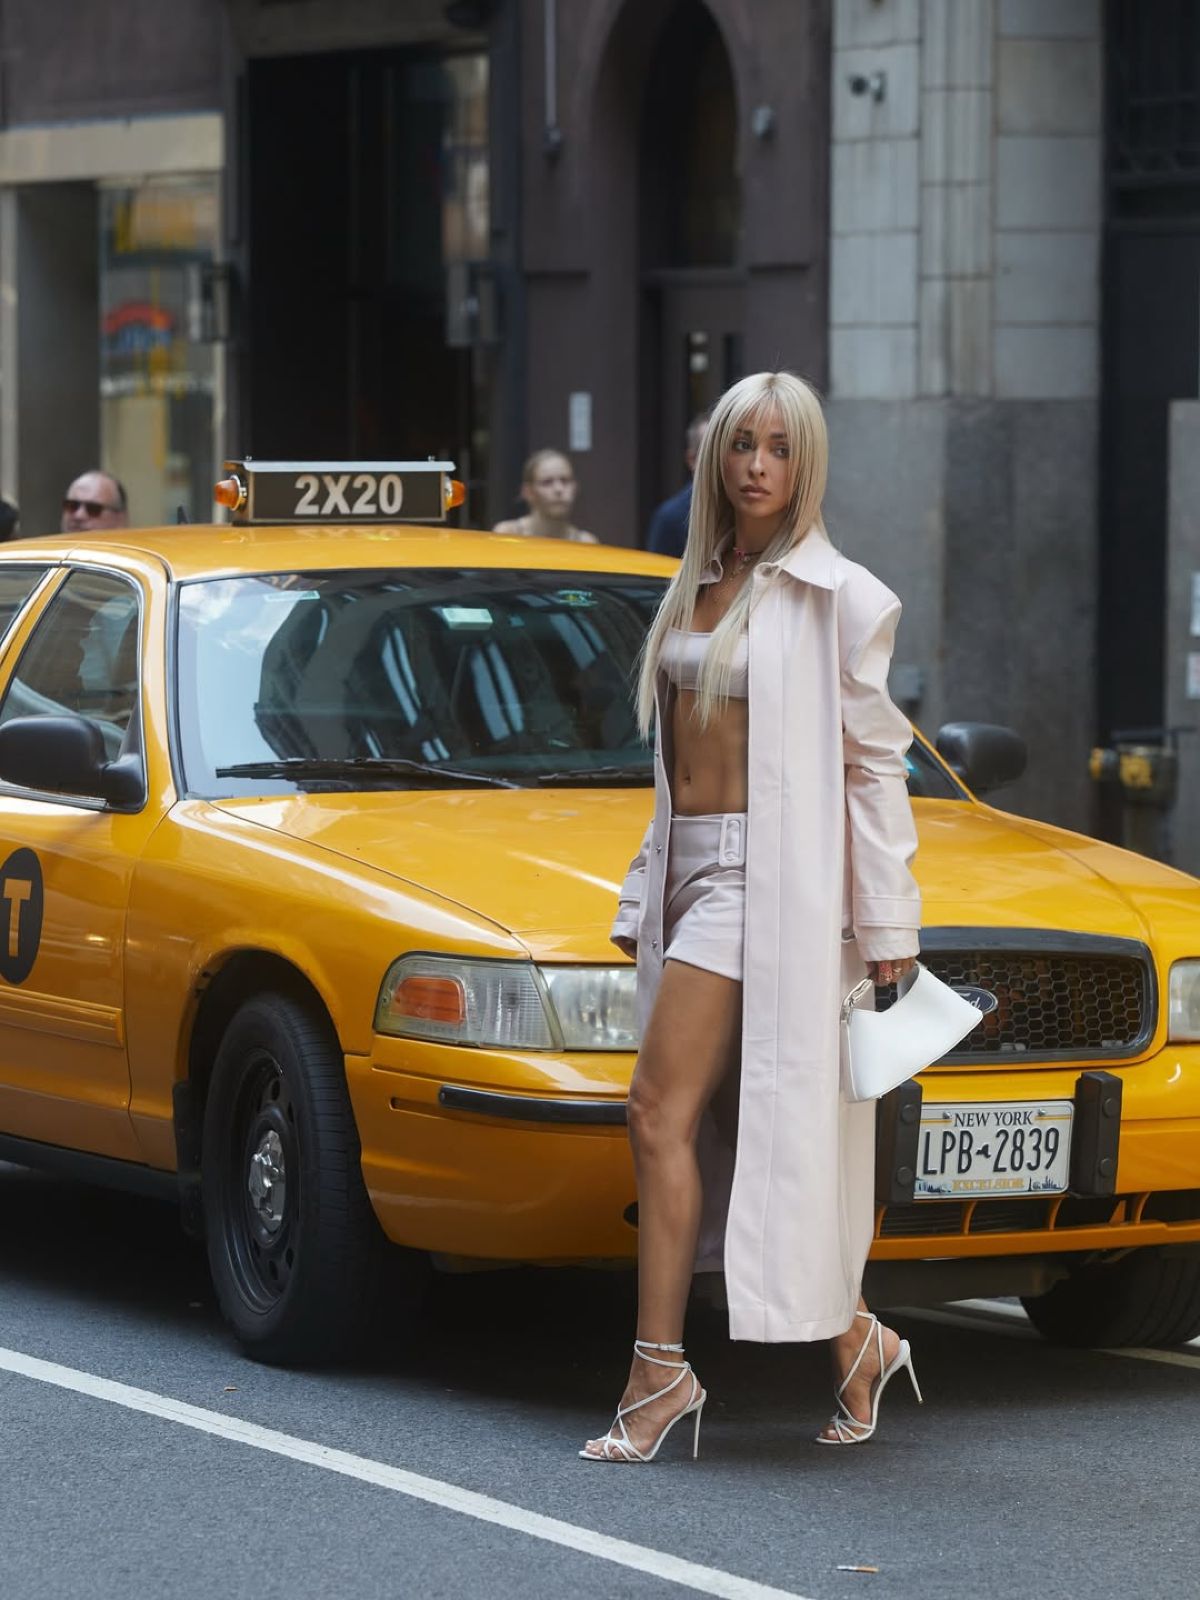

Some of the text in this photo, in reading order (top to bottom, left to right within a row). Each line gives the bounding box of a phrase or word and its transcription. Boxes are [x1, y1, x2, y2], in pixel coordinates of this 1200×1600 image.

[294, 474, 403, 515] 2X20
[3, 878, 32, 957] T
[954, 1110, 1033, 1127] NEW YORK
[923, 1127, 1060, 1175] LPB 2839
